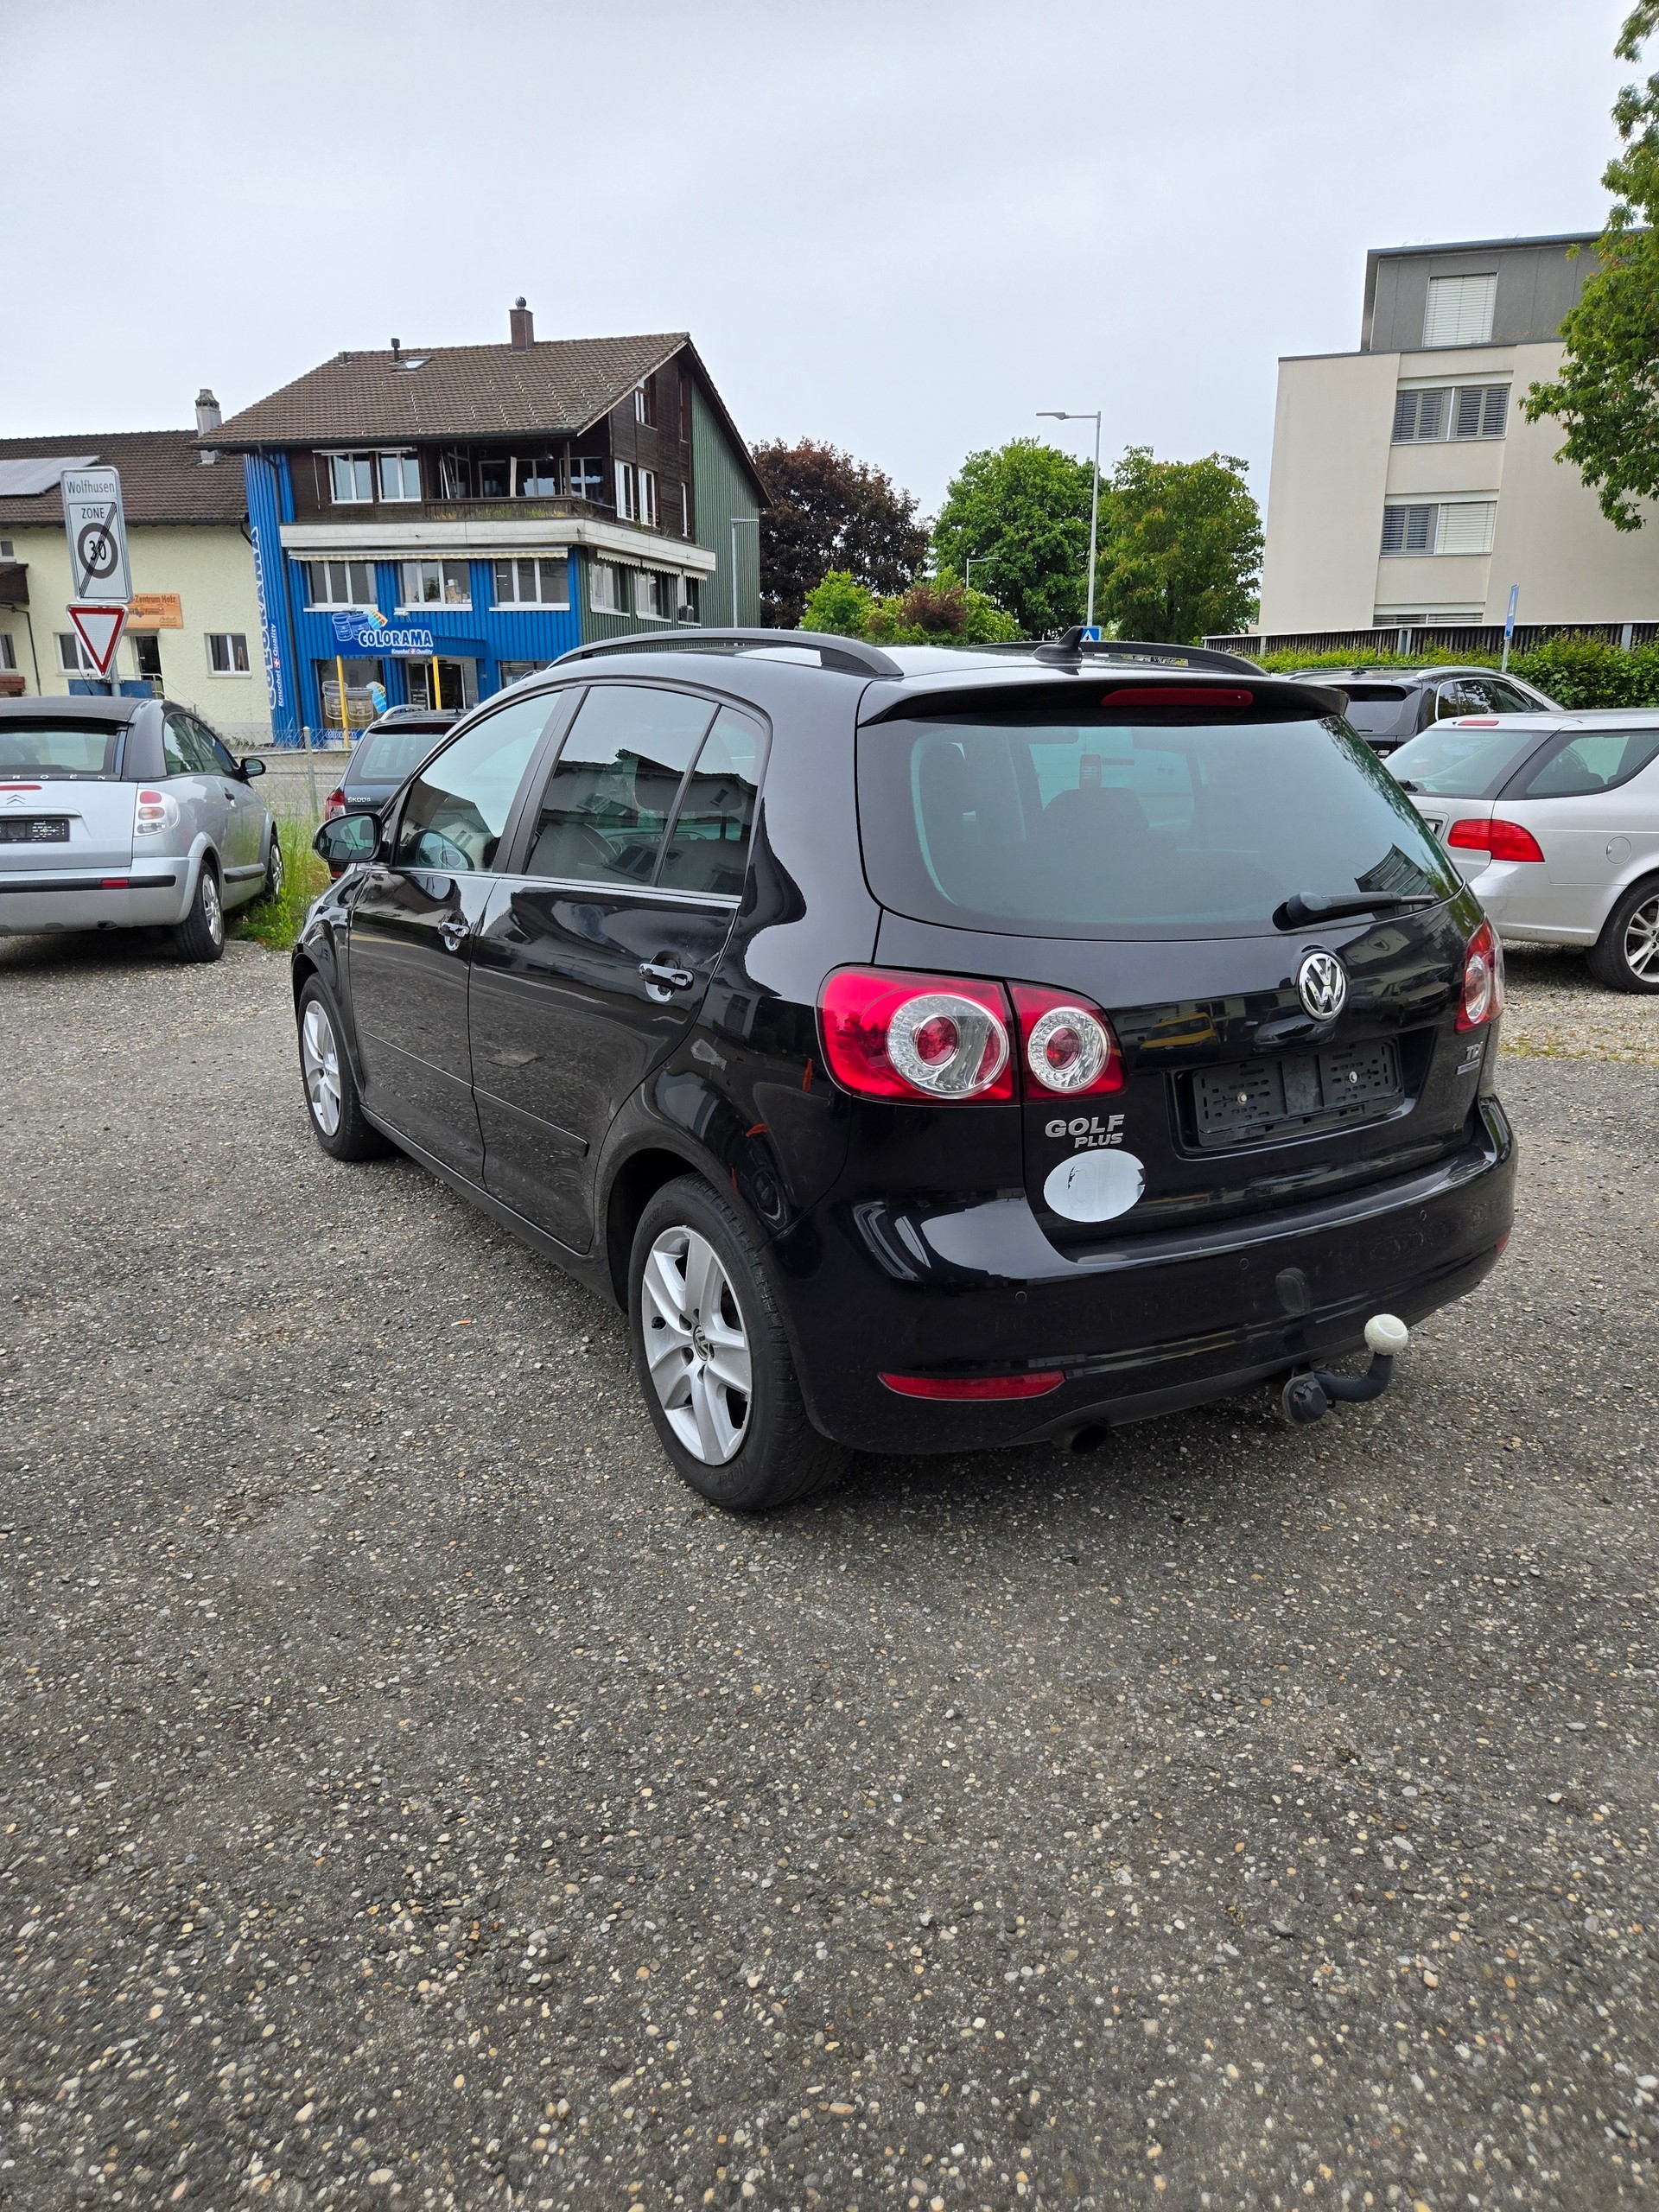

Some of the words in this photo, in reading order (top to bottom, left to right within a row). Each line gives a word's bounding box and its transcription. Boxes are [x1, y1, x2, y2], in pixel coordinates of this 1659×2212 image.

[67, 480, 115, 494] Wolfhusen
[81, 507, 105, 519] ZONE
[89, 540, 107, 561] 30
[162, 594, 176, 603] Holz
[270, 623, 279, 657] Quality
[359, 629, 434, 647] COLORAMA
[275, 670, 285, 707] Knuchel
[1045, 1114, 1125, 1138] GOLF
[1074, 1132, 1124, 1148] PLUS
